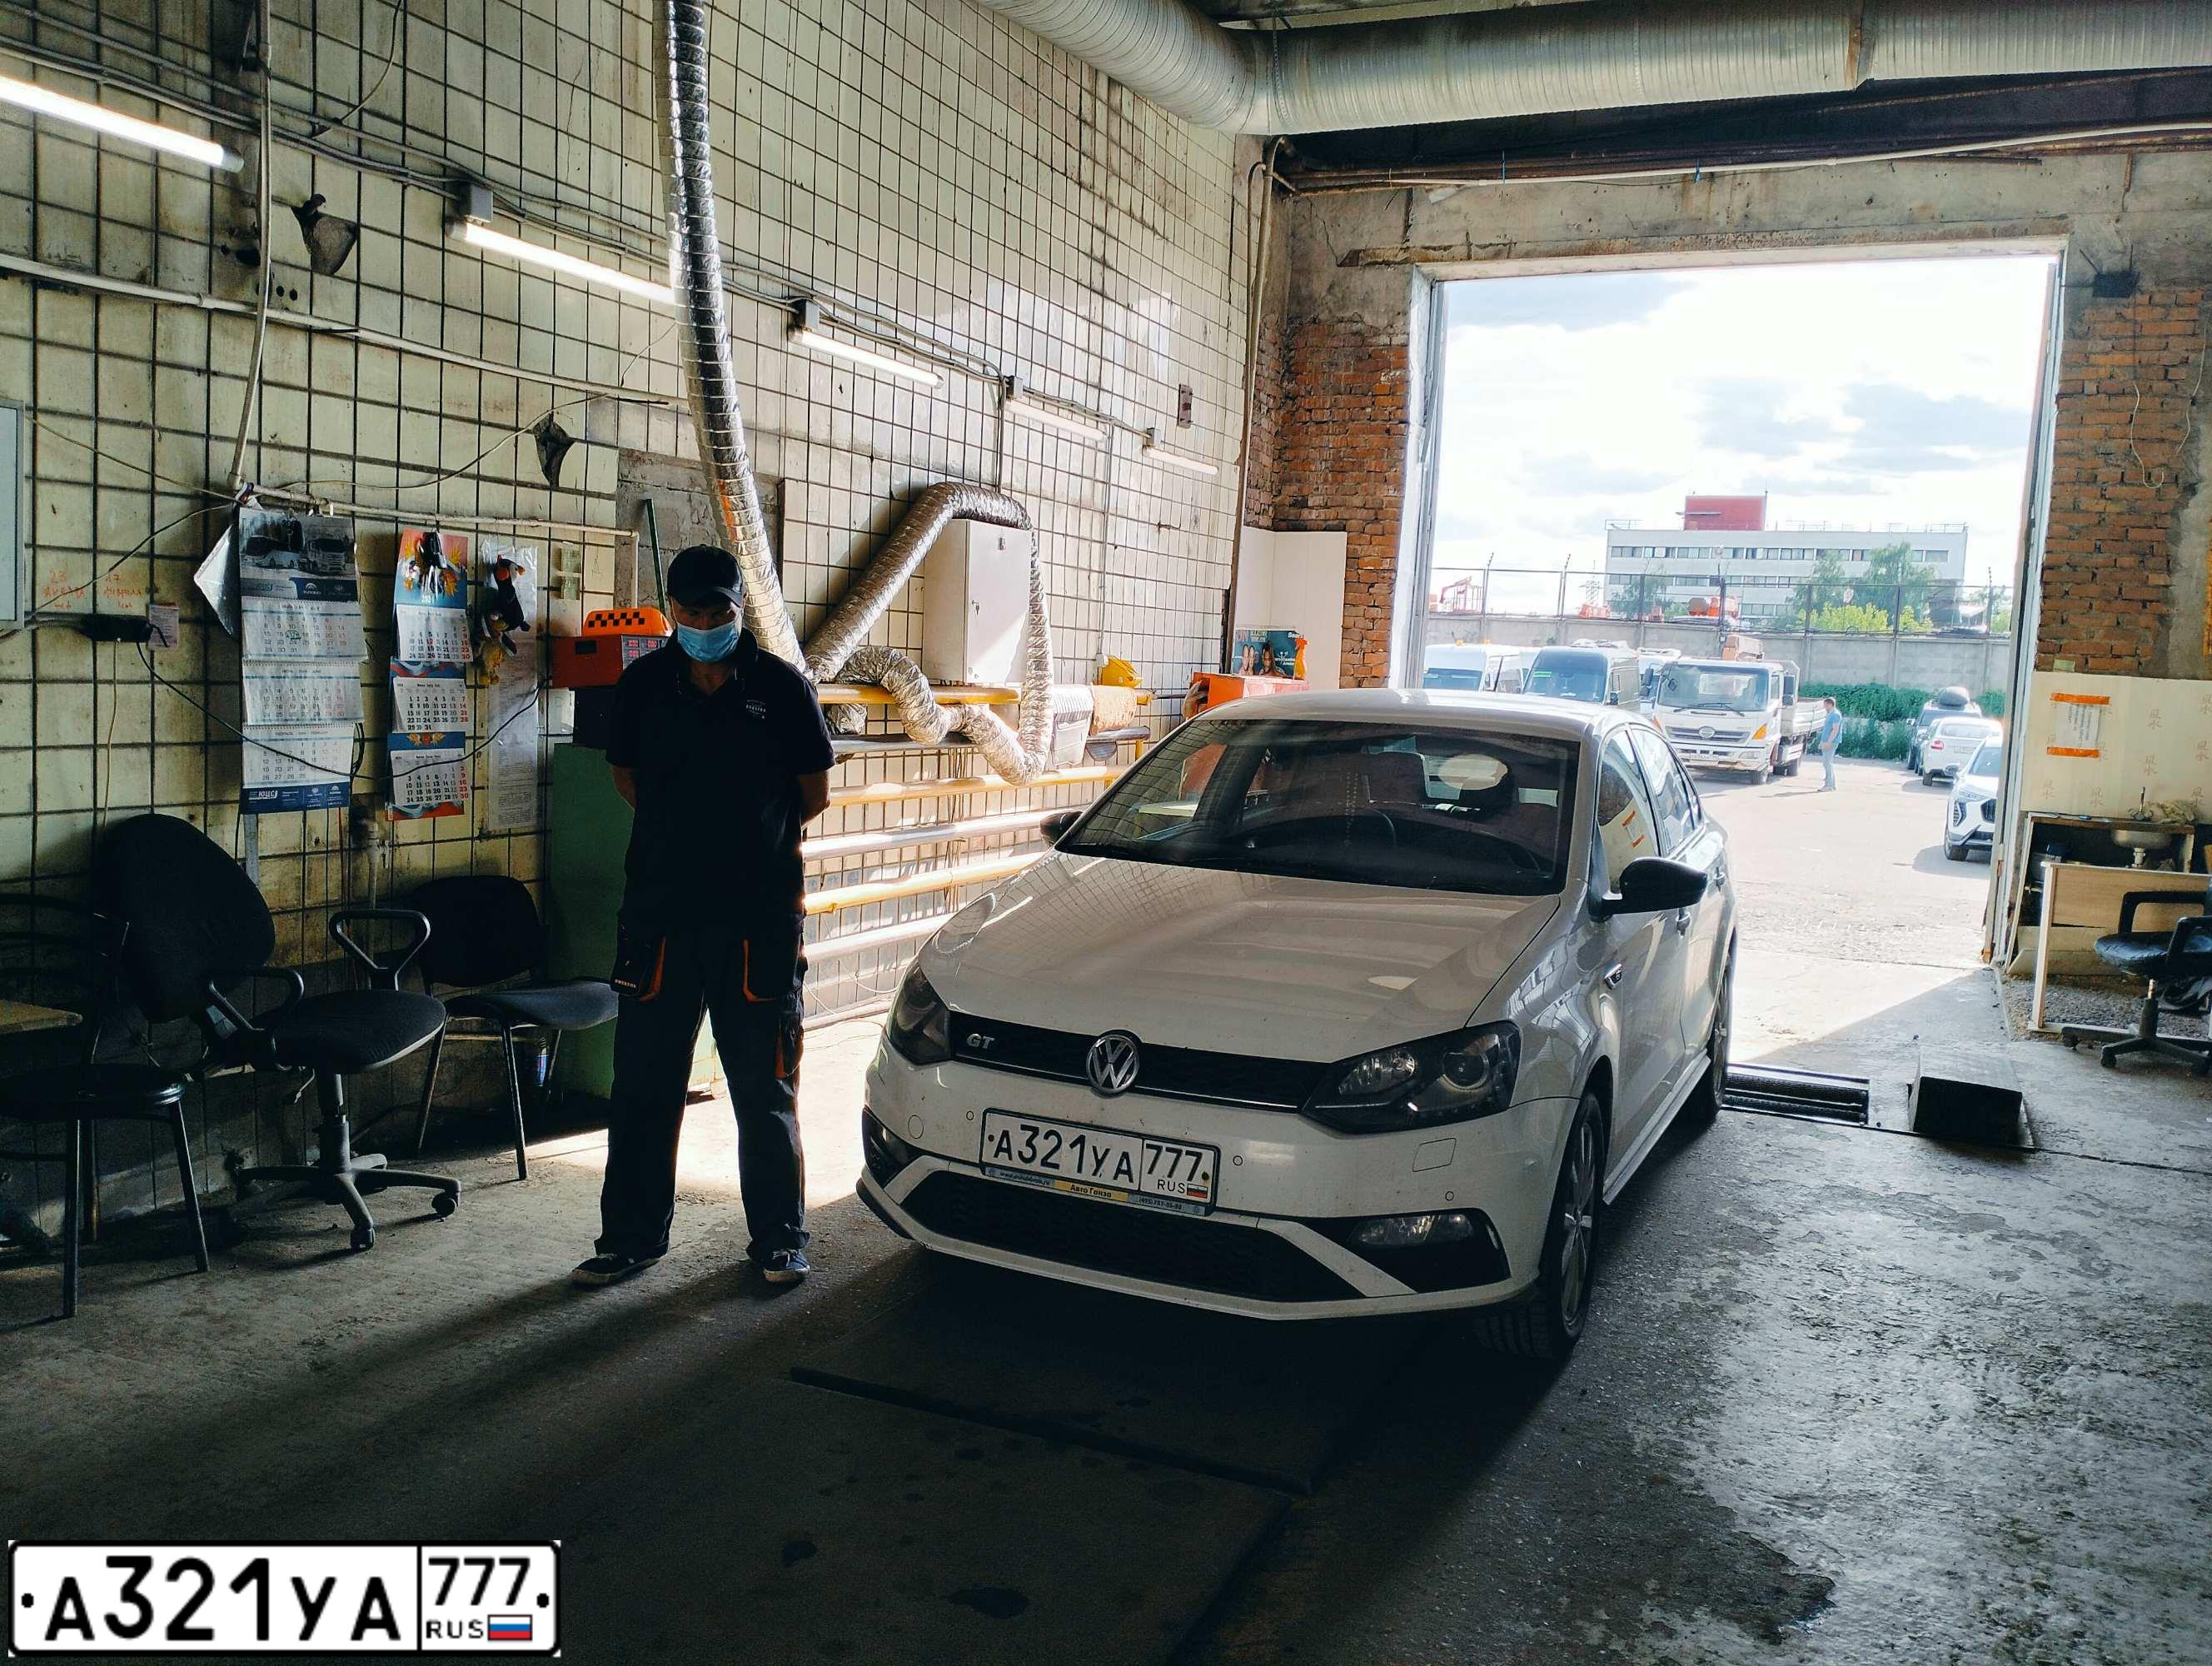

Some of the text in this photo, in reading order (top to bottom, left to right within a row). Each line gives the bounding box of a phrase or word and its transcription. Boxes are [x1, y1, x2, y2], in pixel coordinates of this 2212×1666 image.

[966, 1033, 995, 1050] GT
[1145, 1143, 1203, 1181] 777
[1158, 1179, 1185, 1194] RUS
